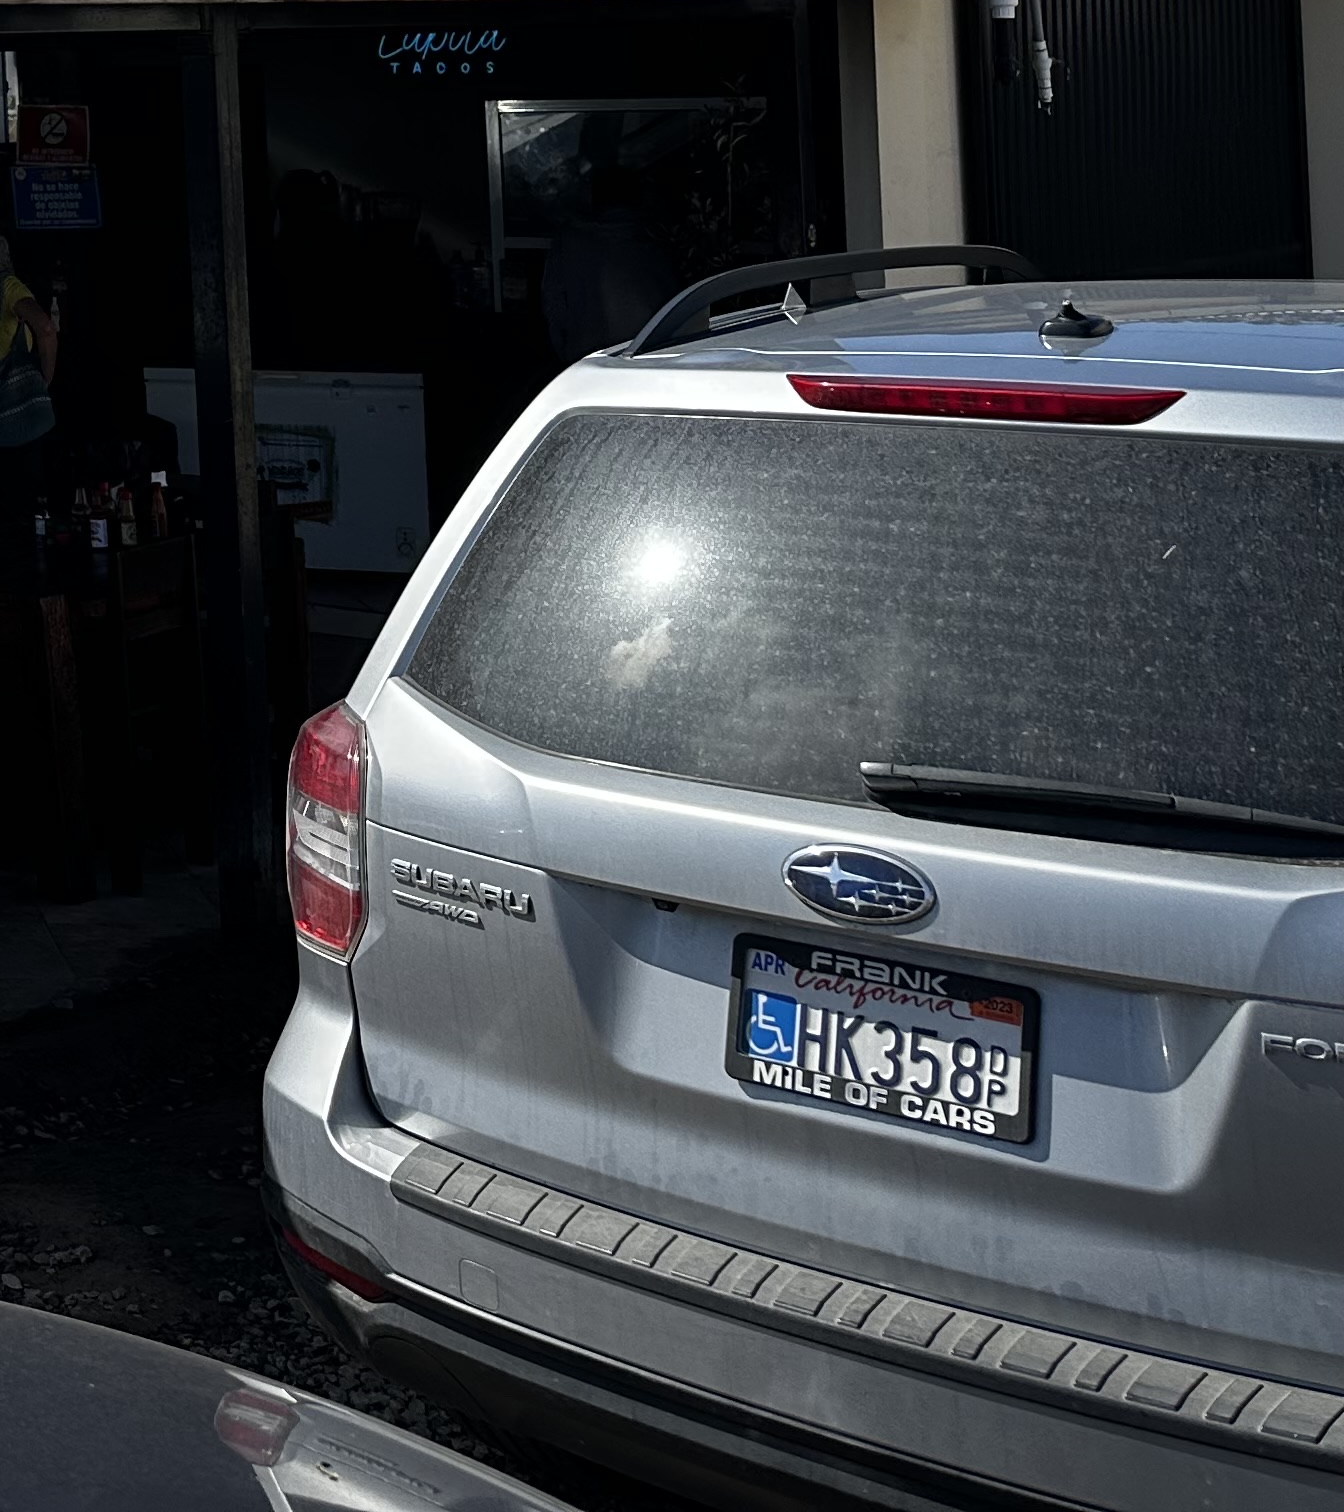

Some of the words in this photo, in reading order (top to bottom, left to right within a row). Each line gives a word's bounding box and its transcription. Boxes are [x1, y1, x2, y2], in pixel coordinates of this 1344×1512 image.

[391, 858, 529, 915] SUBARU
[421, 900, 479, 925] AWD
[752, 951, 786, 976] APR
[811, 951, 948, 995] FRANK
[795, 969, 974, 1021] California
[984, 998, 1014, 1014] 2023
[844, 1082, 888, 1111] OF
[900, 1094, 996, 1136] CARS
